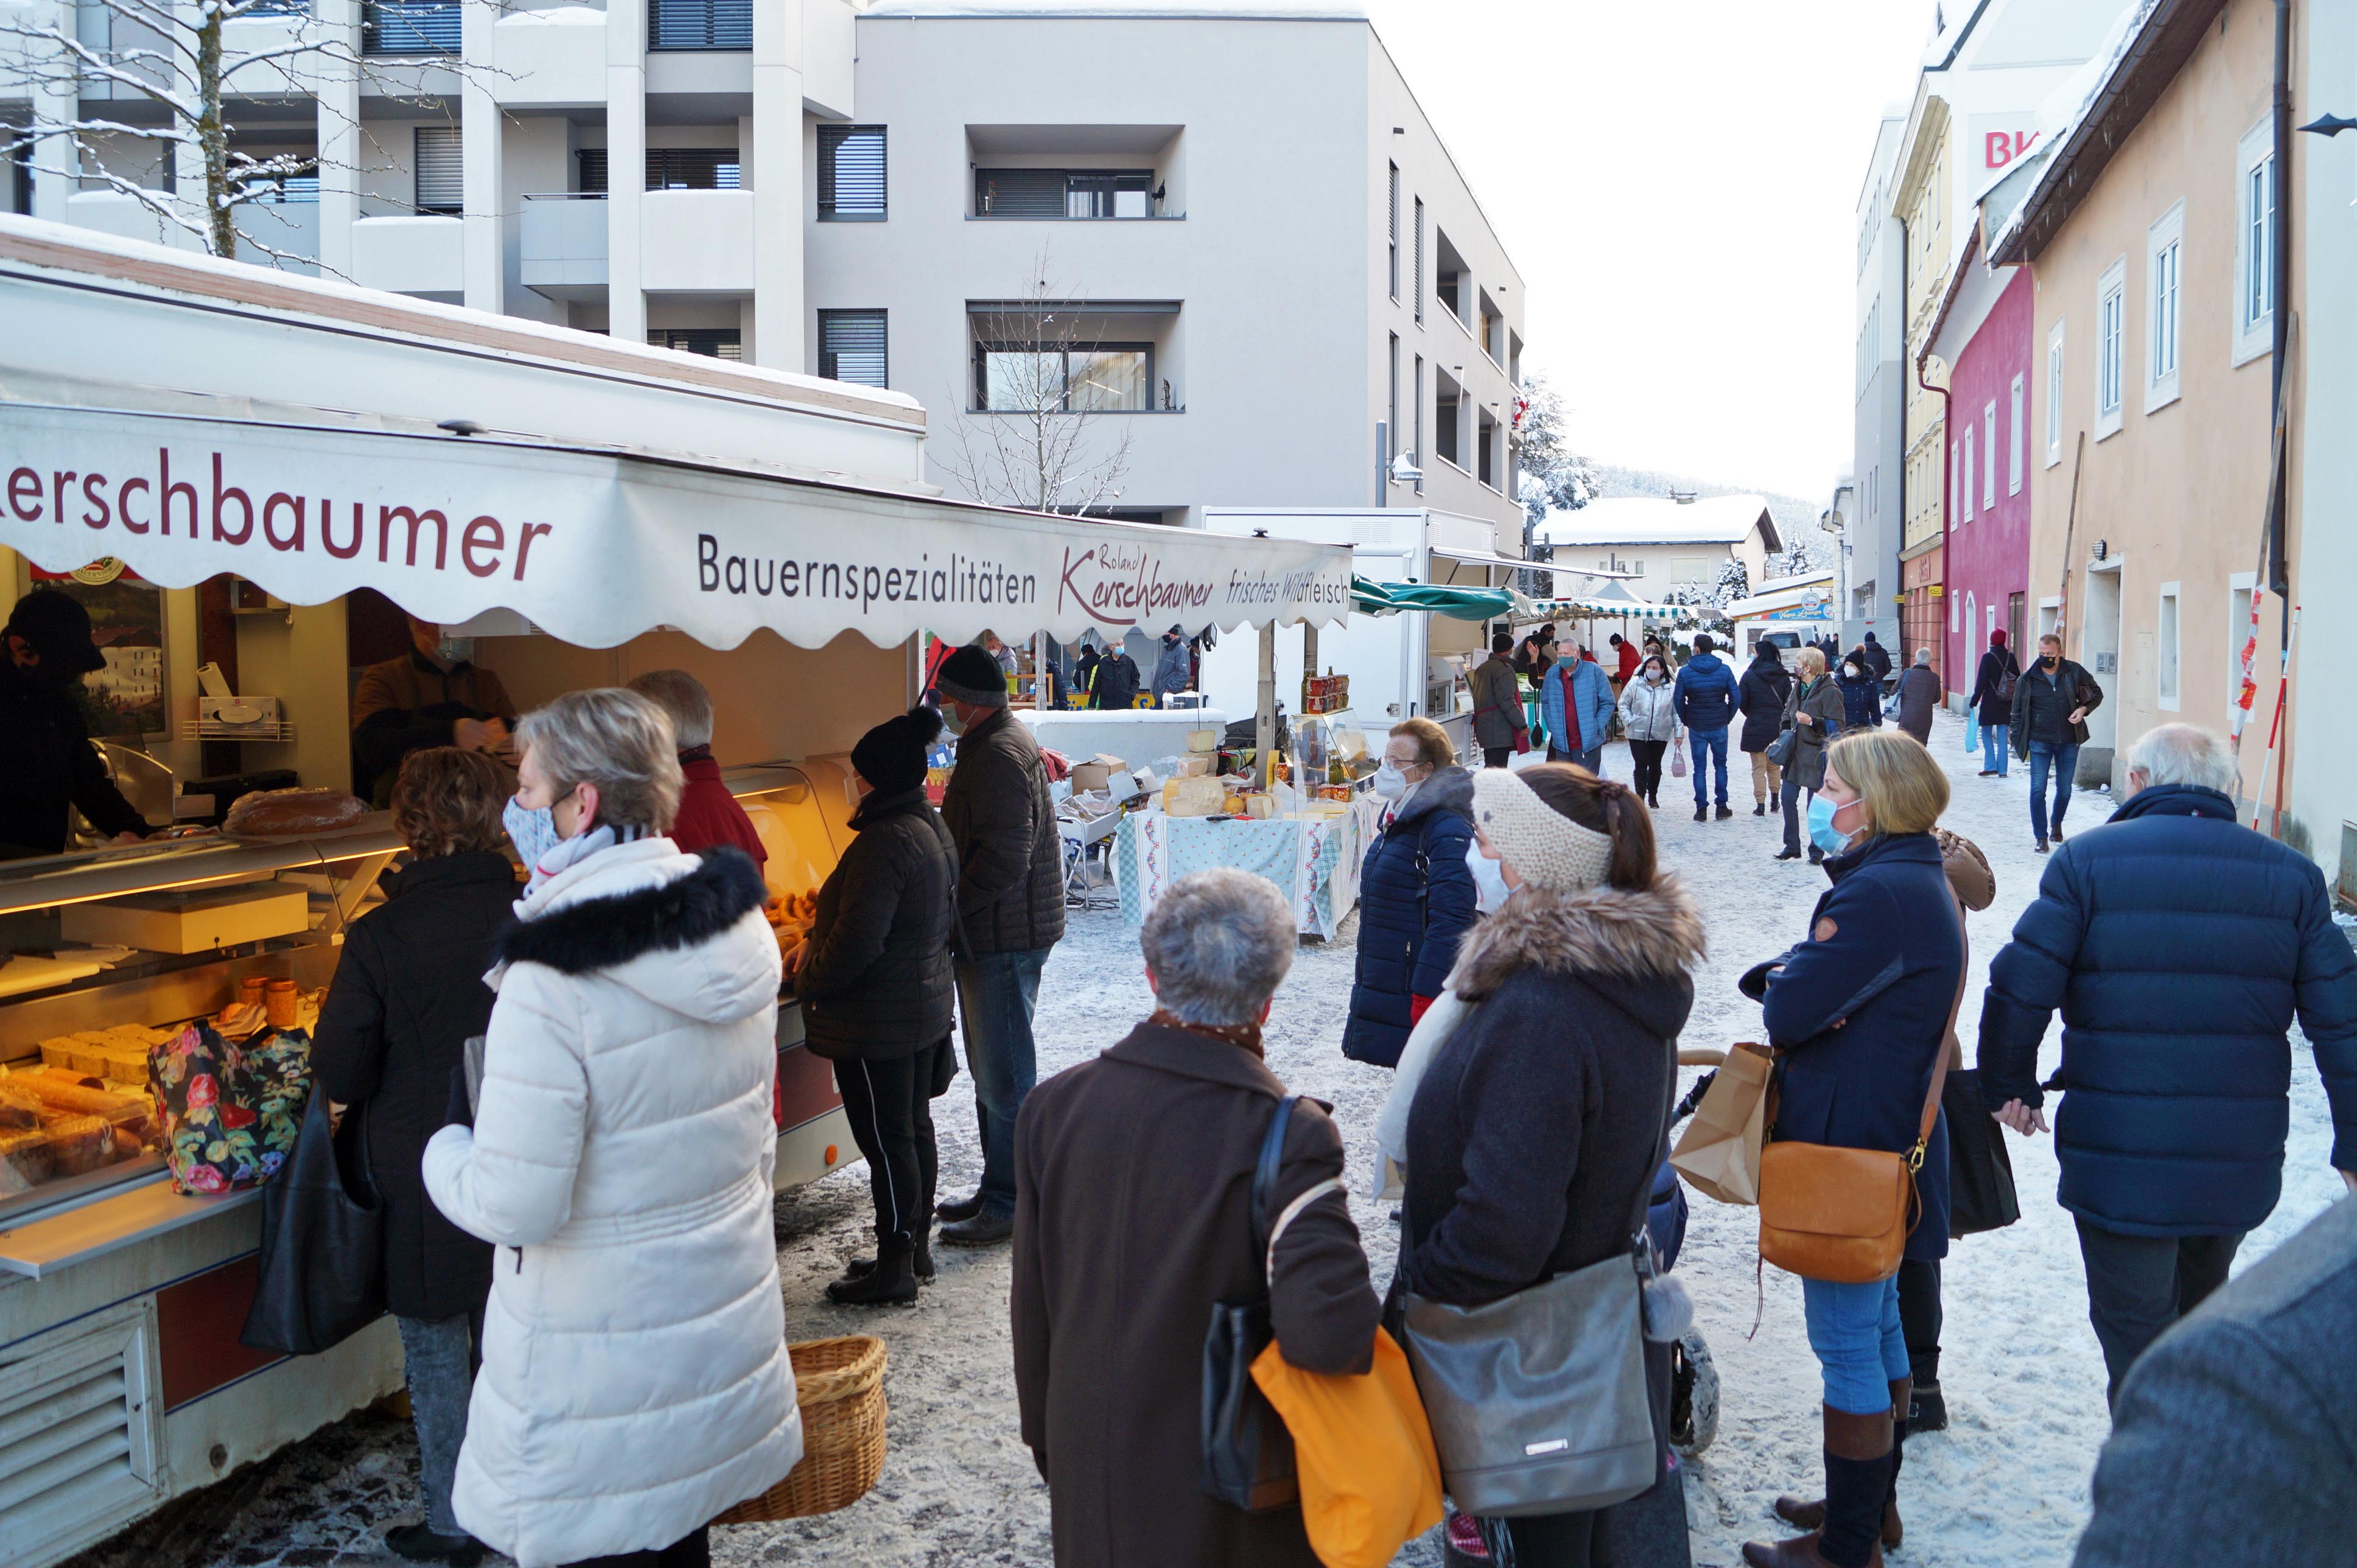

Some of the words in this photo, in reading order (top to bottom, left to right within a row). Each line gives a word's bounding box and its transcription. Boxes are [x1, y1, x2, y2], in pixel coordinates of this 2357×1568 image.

[0, 447, 552, 581] erschbaumer
[698, 533, 1036, 614] Bauernspezialitäten
[1058, 546, 1213, 625] Kerschbaumer
[1099, 543, 1140, 571] Roland
[1226, 568, 1279, 604] frisches
[1281, 571, 1349, 604] Wildfleisch
